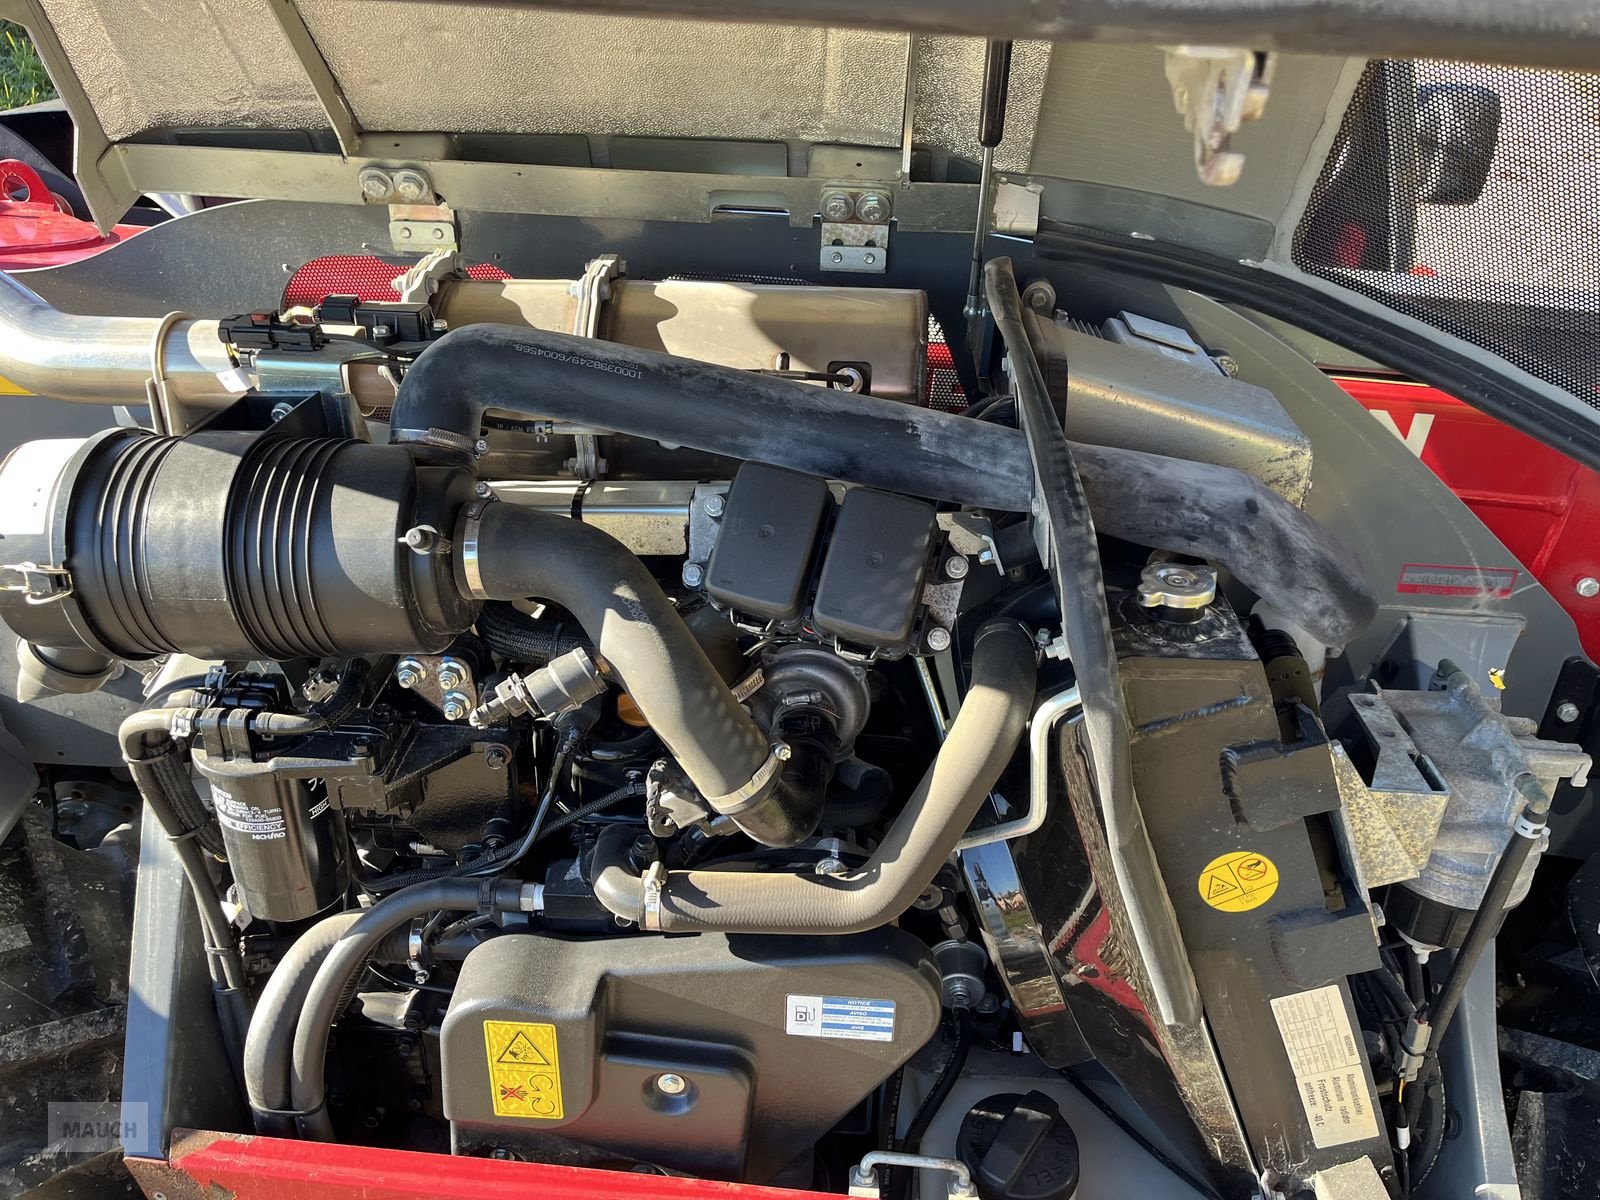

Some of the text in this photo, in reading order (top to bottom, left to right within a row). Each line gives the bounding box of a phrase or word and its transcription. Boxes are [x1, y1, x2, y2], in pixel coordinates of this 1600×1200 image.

[311, 801, 328, 815] HIGH
[236, 822, 282, 831] EFFICIENCY
[1317, 1078, 1333, 1113] Frostschutz
